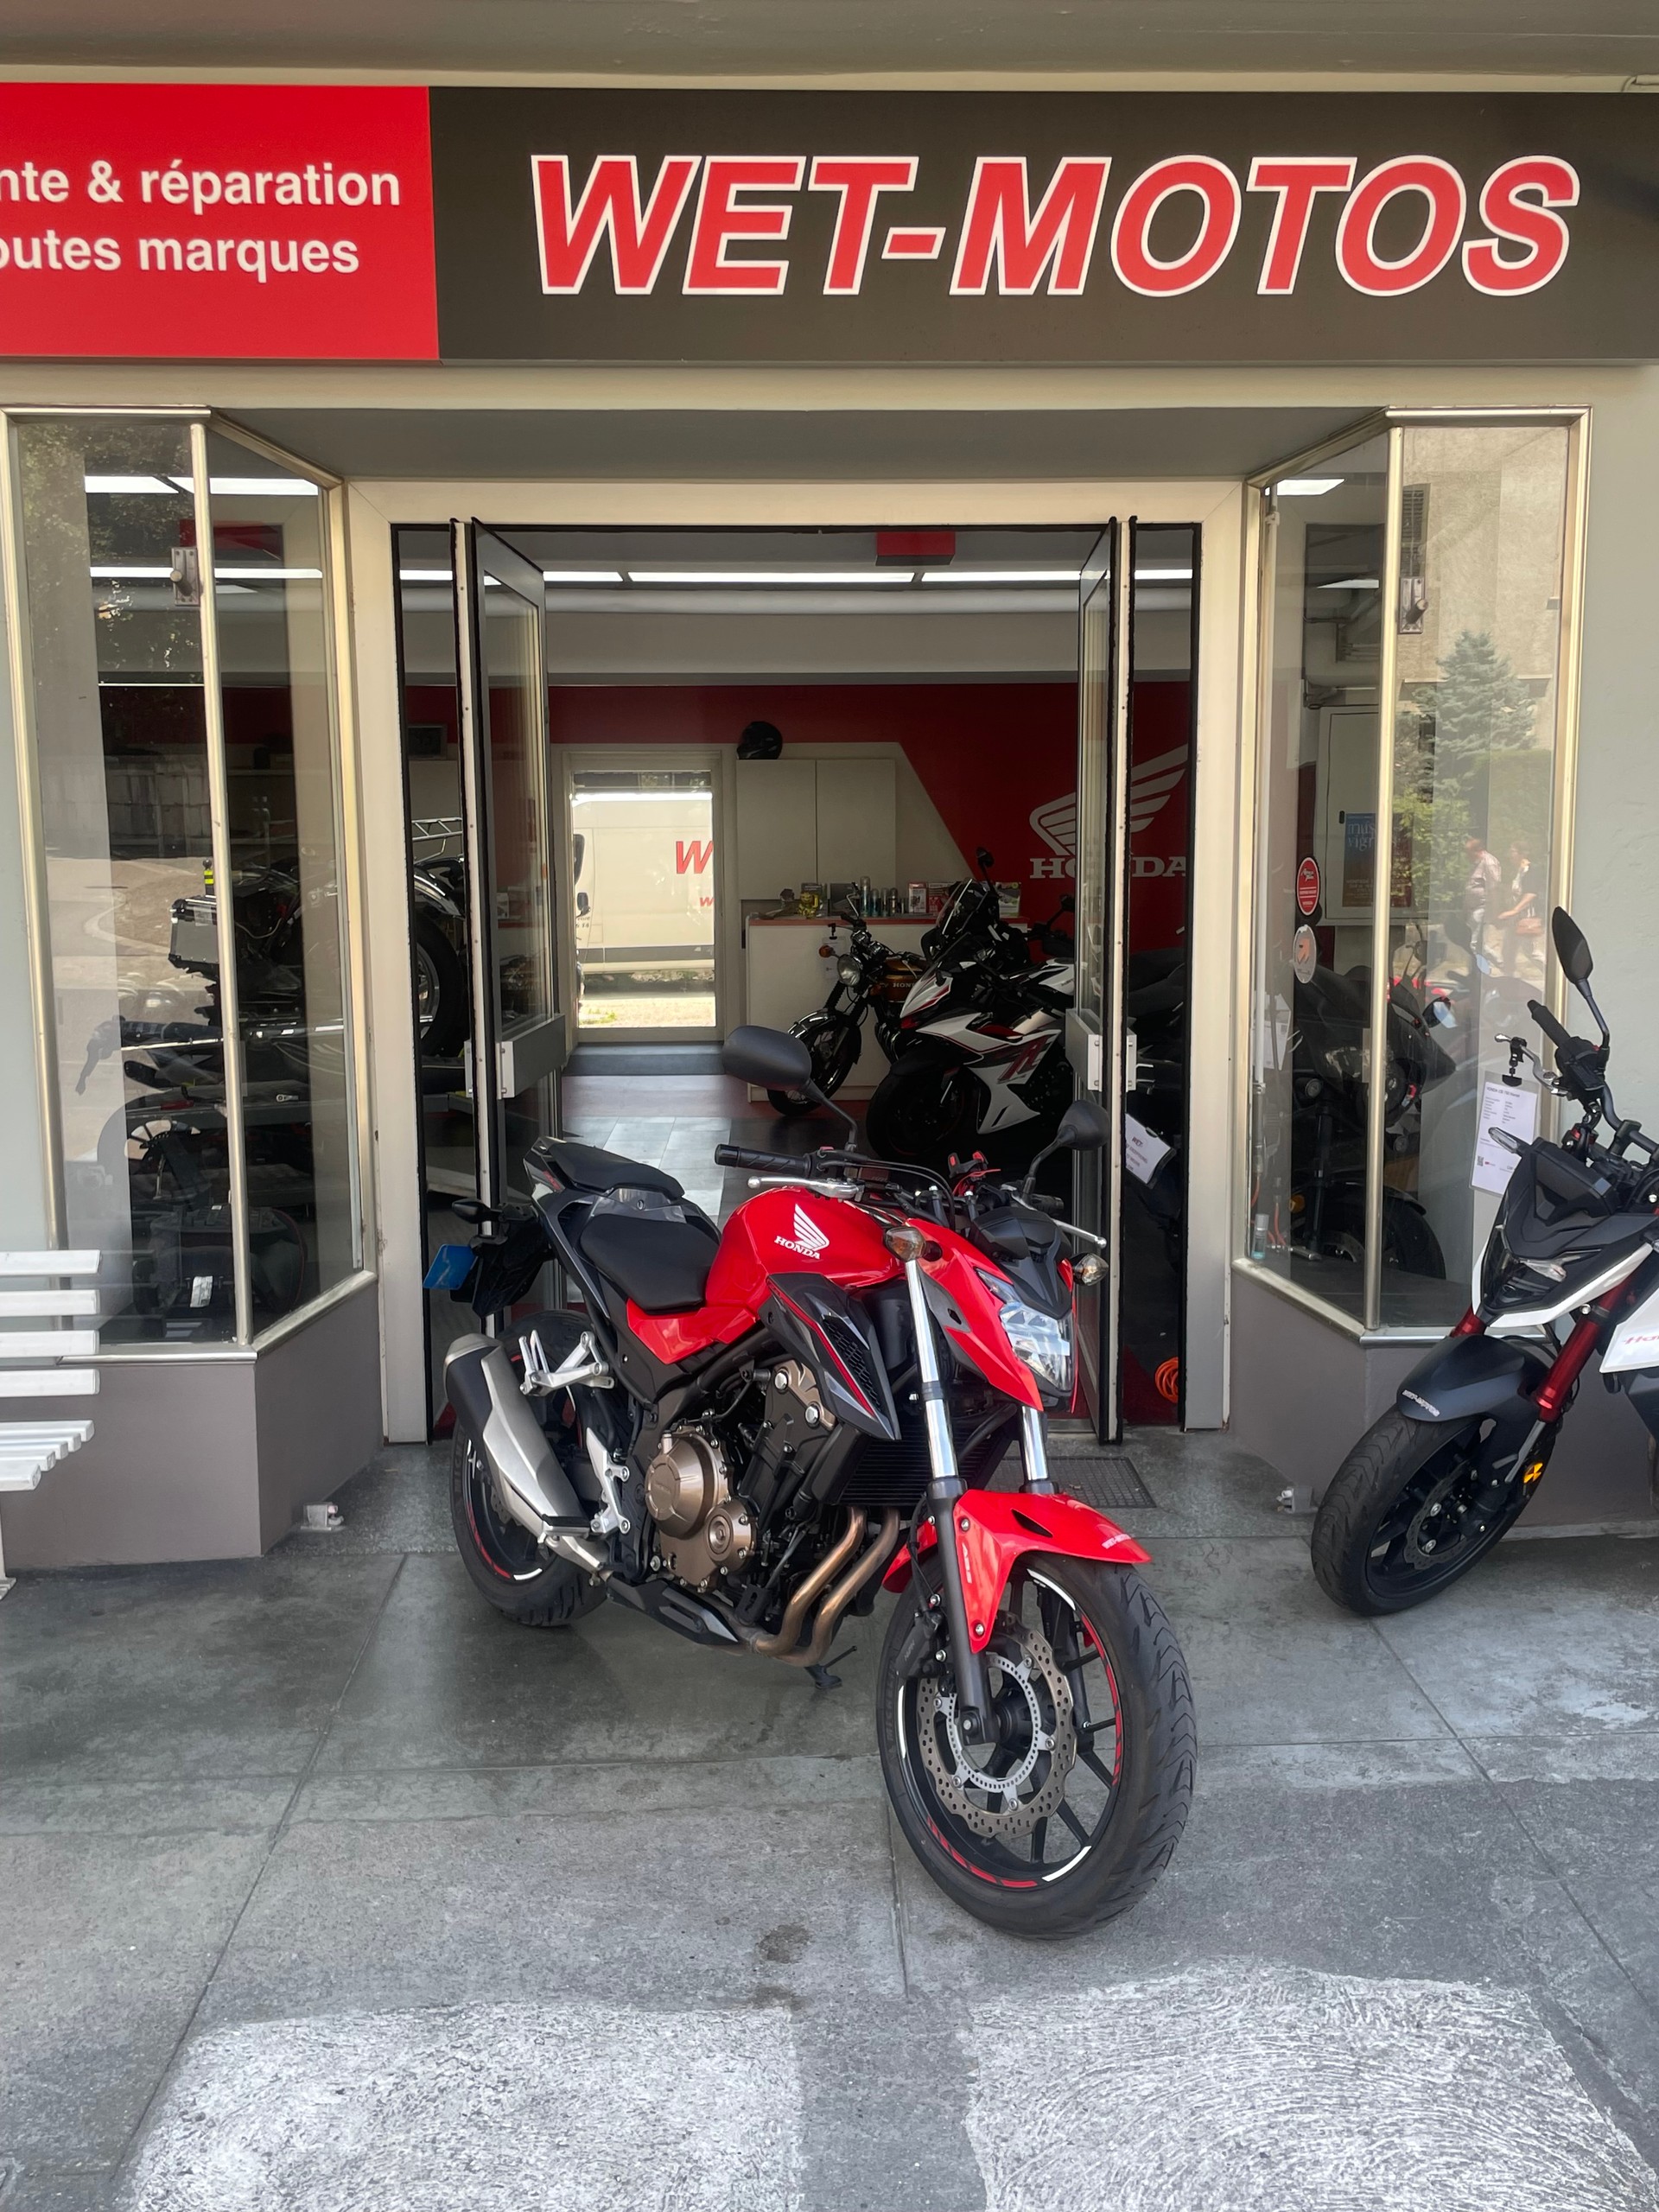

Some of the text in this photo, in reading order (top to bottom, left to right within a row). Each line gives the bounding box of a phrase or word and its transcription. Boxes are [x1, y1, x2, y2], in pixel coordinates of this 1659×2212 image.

[0, 159, 400, 215] nte & réparation
[530, 154, 1580, 296] WET-MOTOS
[138, 238, 359, 283] marques
[1029, 856, 1186, 879] HDA
[773, 1235, 821, 1260] HONDA
